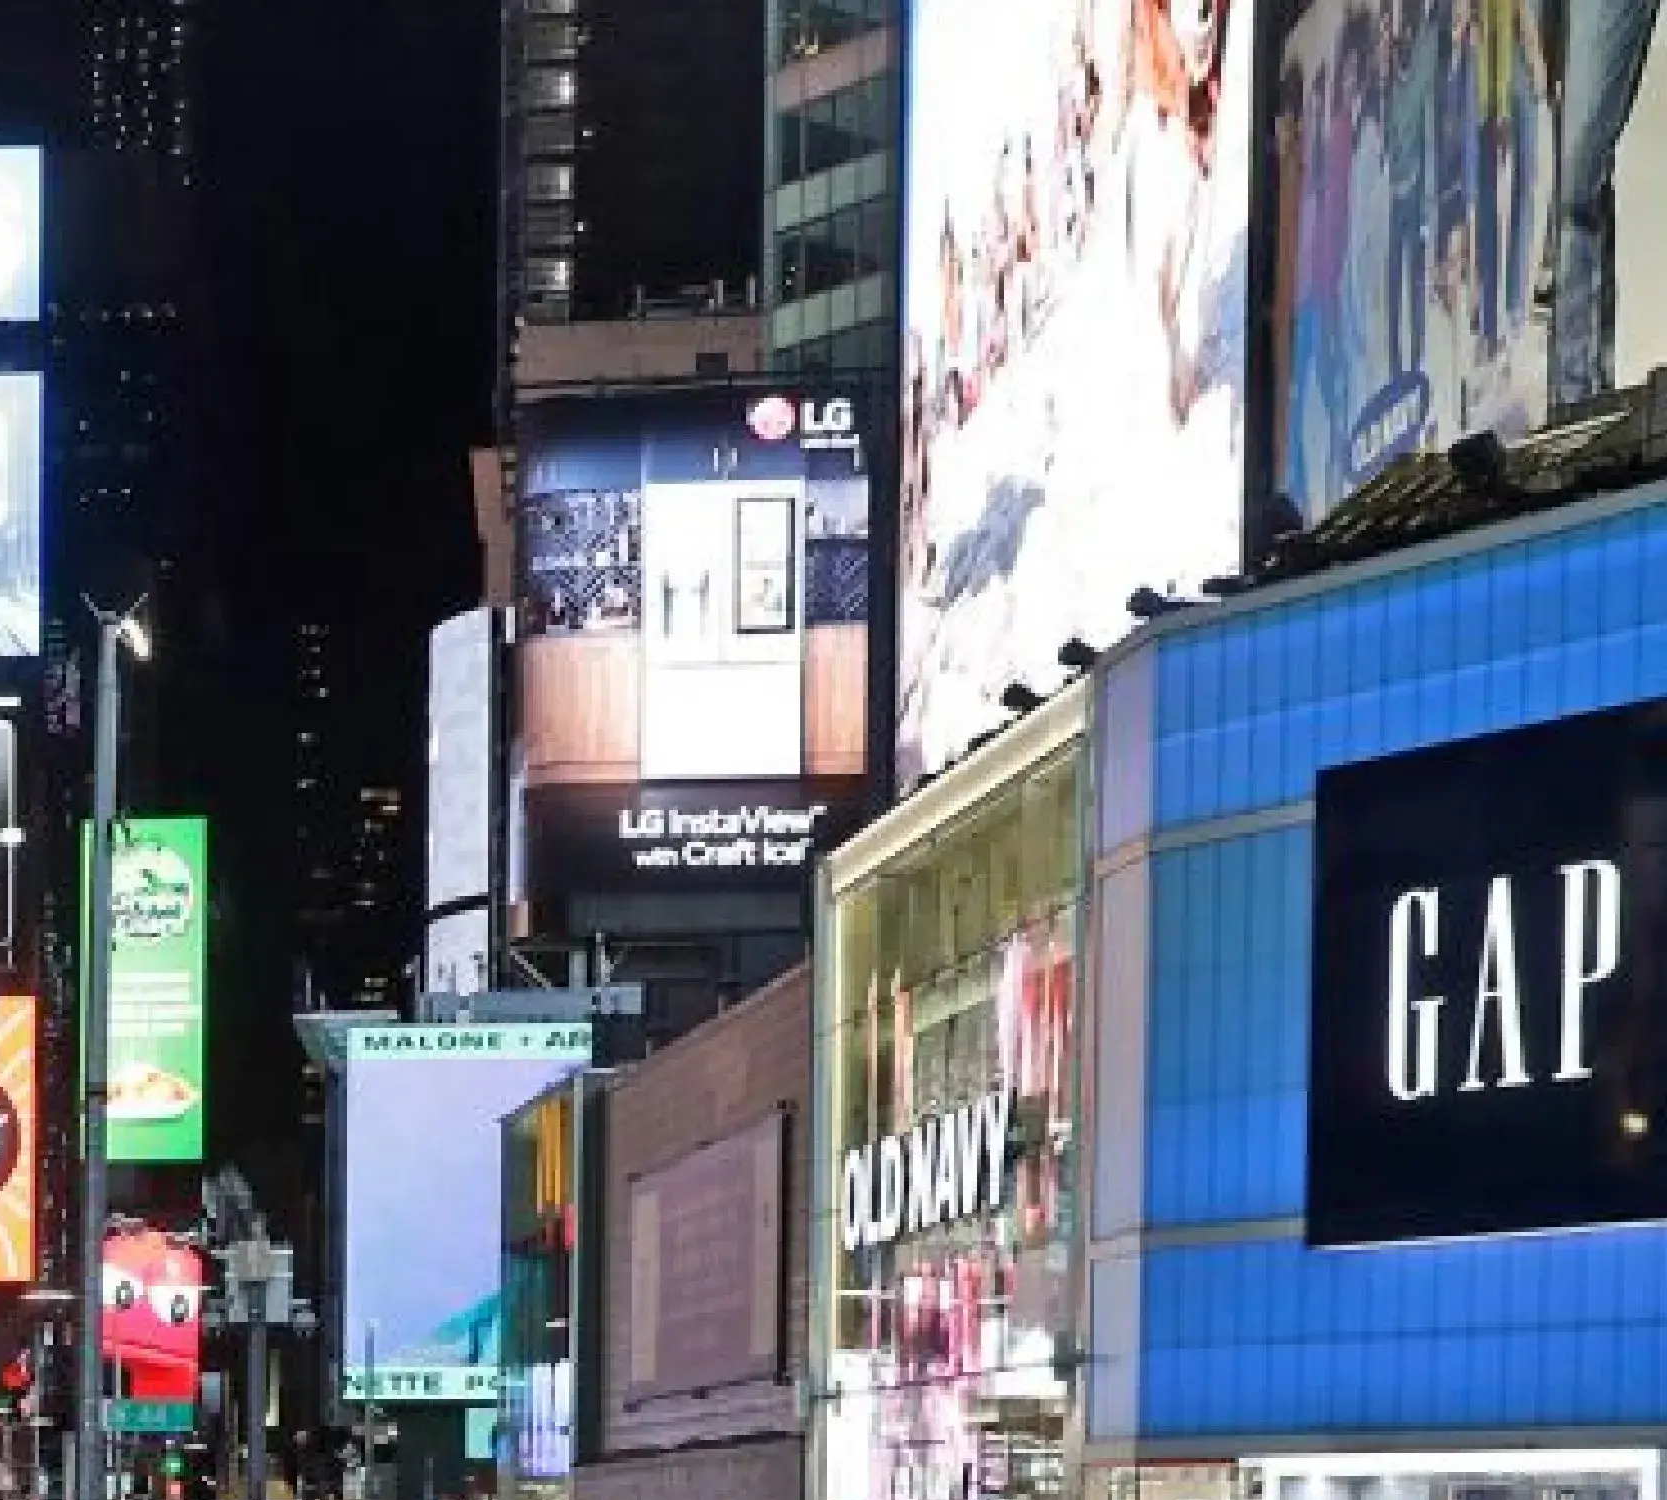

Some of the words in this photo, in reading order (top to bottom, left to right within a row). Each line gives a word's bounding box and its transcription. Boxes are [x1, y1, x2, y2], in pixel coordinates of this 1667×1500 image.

[799, 397, 854, 432] LG
[1386, 857, 1622, 1101] GAP
[844, 1136, 903, 1251] OLD
[908, 1080, 1010, 1233] NAVY
